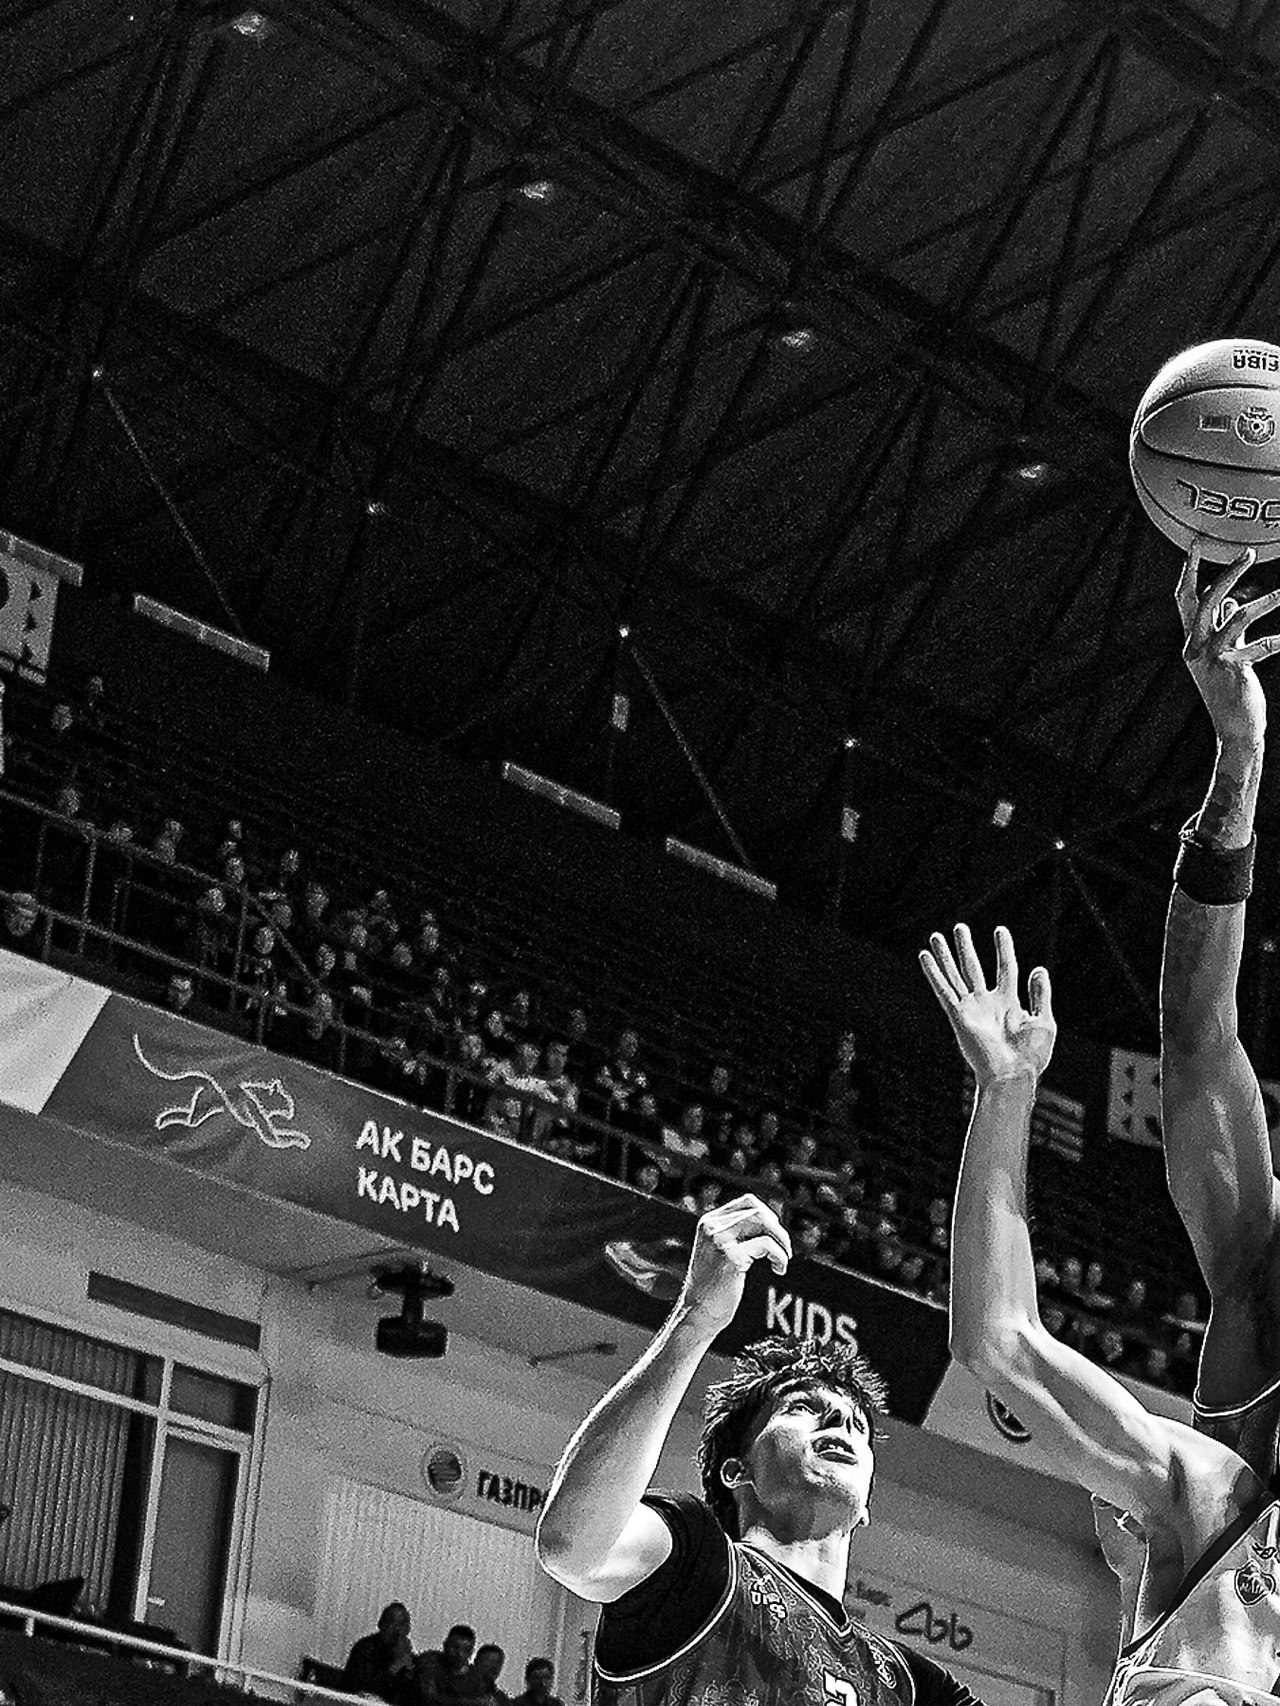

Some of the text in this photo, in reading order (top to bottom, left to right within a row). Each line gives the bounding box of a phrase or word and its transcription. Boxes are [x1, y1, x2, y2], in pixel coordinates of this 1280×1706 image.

[356, 1120, 496, 1195] АК БАРС
[357, 1166, 460, 1234] КАРТА
[766, 1286, 860, 1360] KIDS
